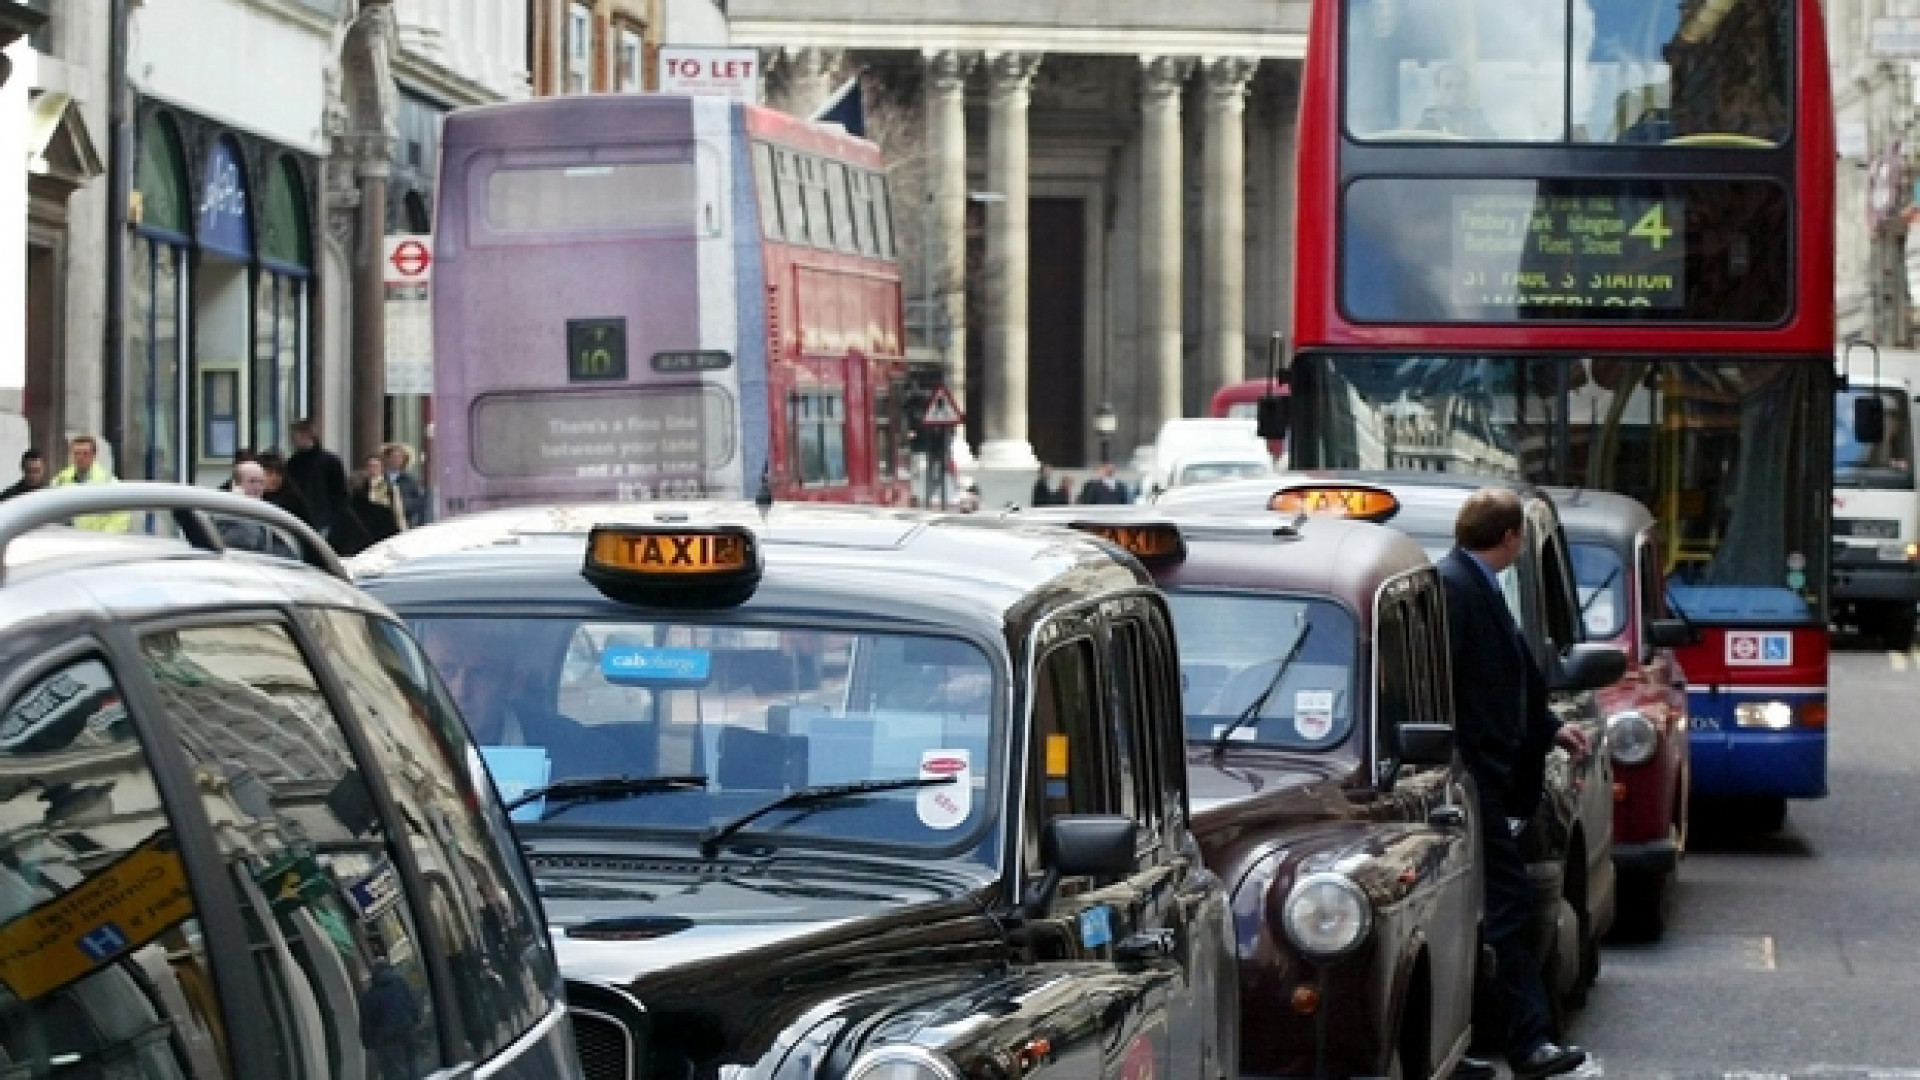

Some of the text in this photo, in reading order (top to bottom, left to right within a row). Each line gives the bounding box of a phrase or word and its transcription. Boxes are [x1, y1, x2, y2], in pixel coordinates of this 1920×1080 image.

[665, 58, 753, 79] TO LET
[1628, 202, 1674, 252] 4
[622, 536, 708, 565] TAXI
